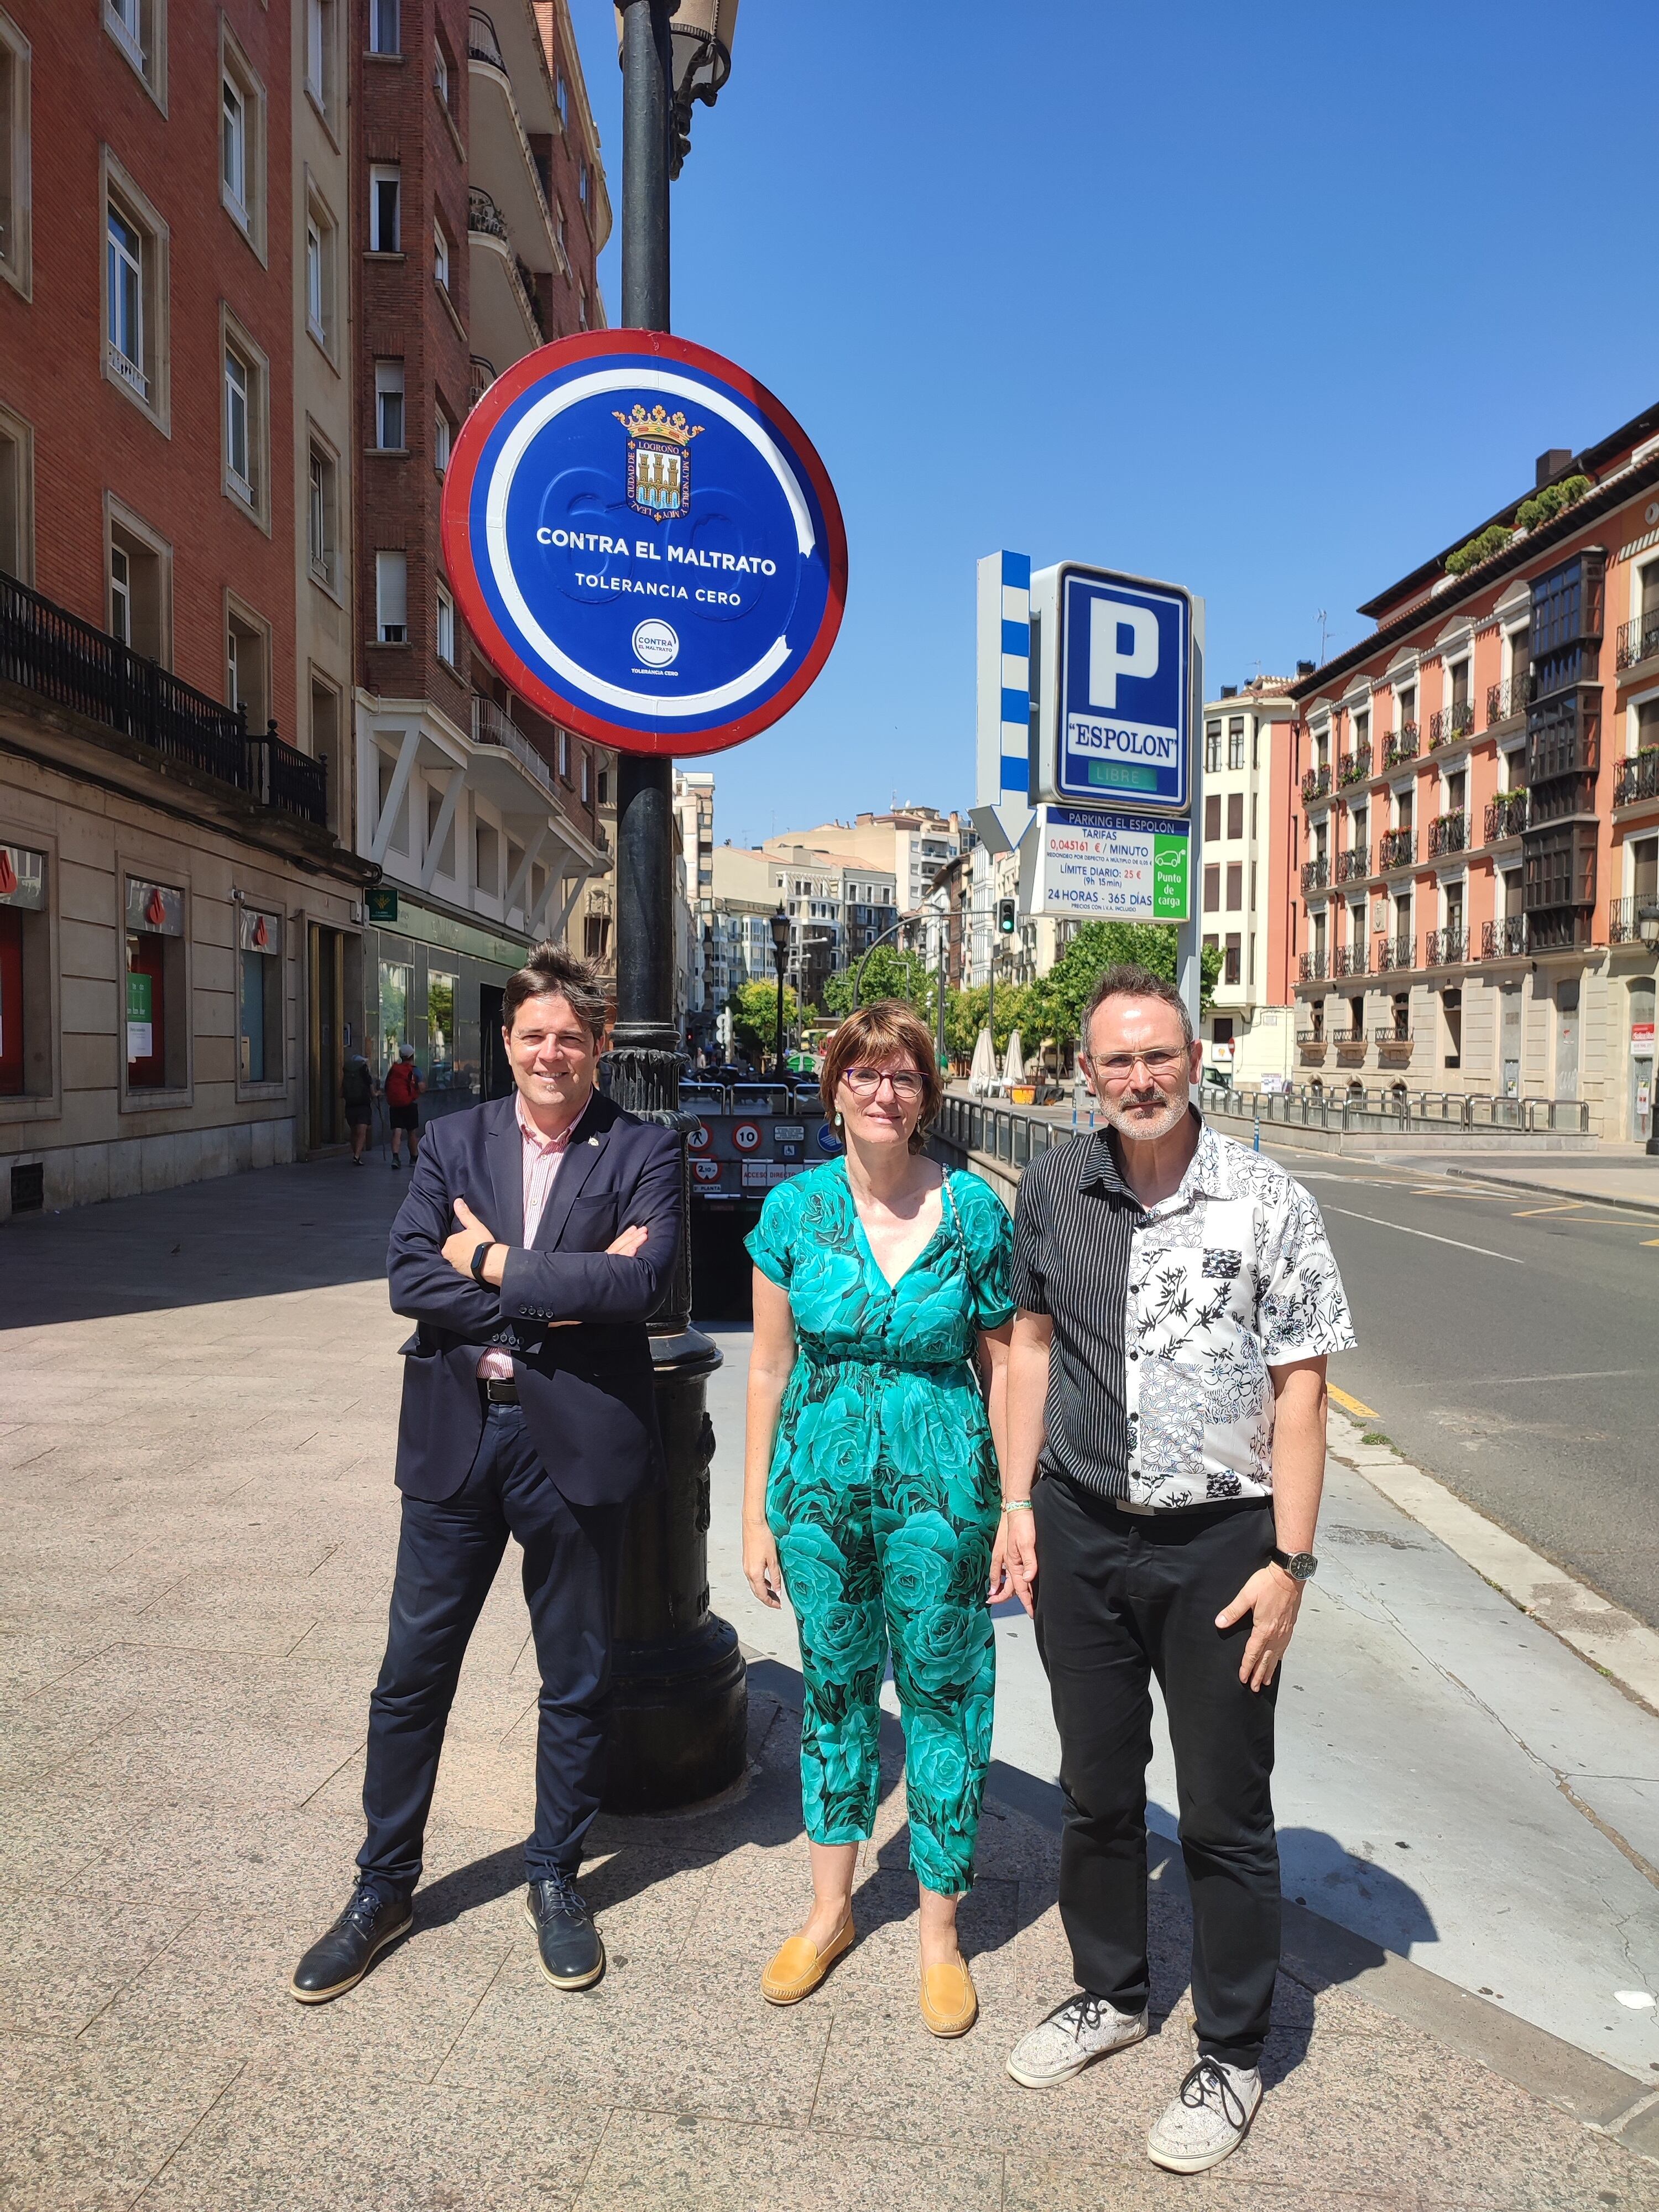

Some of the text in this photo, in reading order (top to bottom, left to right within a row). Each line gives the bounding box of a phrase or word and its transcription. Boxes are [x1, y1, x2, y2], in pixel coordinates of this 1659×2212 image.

[638, 441, 679, 455] LOGROÑO
[627, 452, 635, 463] DE
[536, 527, 776, 576] CONTRA EL MALTRATO
[575, 572, 741, 606] TOLERANCIA CERO
[638, 637, 673, 647] CONTRA
[1088, 596, 1159, 709] P
[1097, 766, 1139, 784] LIBRE
[1069, 812, 1175, 834] PARKING EL ESPOLÓN
[1082, 828, 1117, 841] TARIFAS
[1050, 839, 1088, 852] 0,045161
[1094, 843, 1100, 853] €
[1109, 844, 1149, 857] MINUTO
[1060, 863, 1141, 879] LÍMITE DIARIO: 25 €
[1157, 871, 1181, 884] Punto
[1083, 877, 1095, 886] (9h
[1164, 884, 1174, 895] de
[1048, 889, 1060, 900] 24
[1062, 890, 1098, 902] HORAS
[1108, 893, 1126, 904] 365
[1130, 891, 1152, 906] DÍAS
[1158, 896, 1180, 908] carga
[740, 1132, 755, 1142] 10
